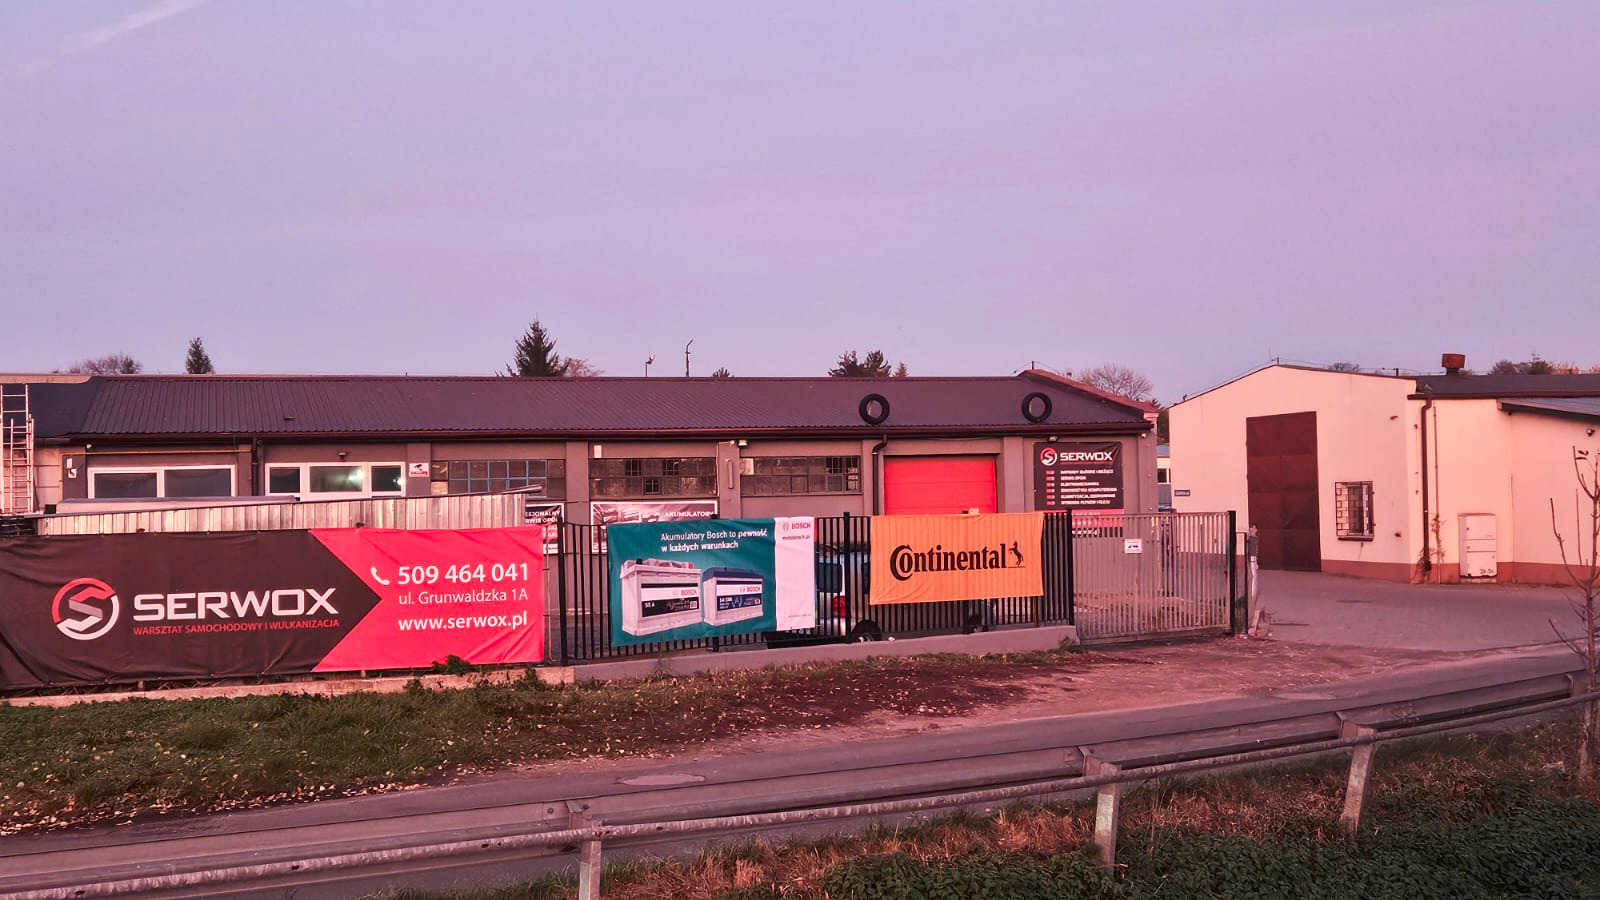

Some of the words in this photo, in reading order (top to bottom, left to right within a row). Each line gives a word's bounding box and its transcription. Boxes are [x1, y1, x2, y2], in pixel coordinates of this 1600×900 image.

[1060, 452, 1112, 461] SERWOX
[661, 532, 705, 541] Akumulatory
[706, 530, 727, 539] Bosch
[738, 528, 768, 540] pewność
[669, 542, 699, 553] każdych
[701, 541, 739, 550] warunkach
[890, 543, 1007, 581] Continental
[398, 566, 439, 584] 509
[444, 564, 486, 583] 464
[491, 563, 528, 582] 041
[399, 592, 415, 604] ul.
[418, 589, 507, 604] Grunwaldzka
[512, 588, 528, 600] 1A
[133, 588, 339, 621] SERWOX
[133, 625, 182, 635] WARSZTAT
[185, 622, 263, 634] SAMOCHODOWY
[270, 619, 340, 630] WULKANIZACJA
[398, 610, 527, 630] www.serwox.pl
